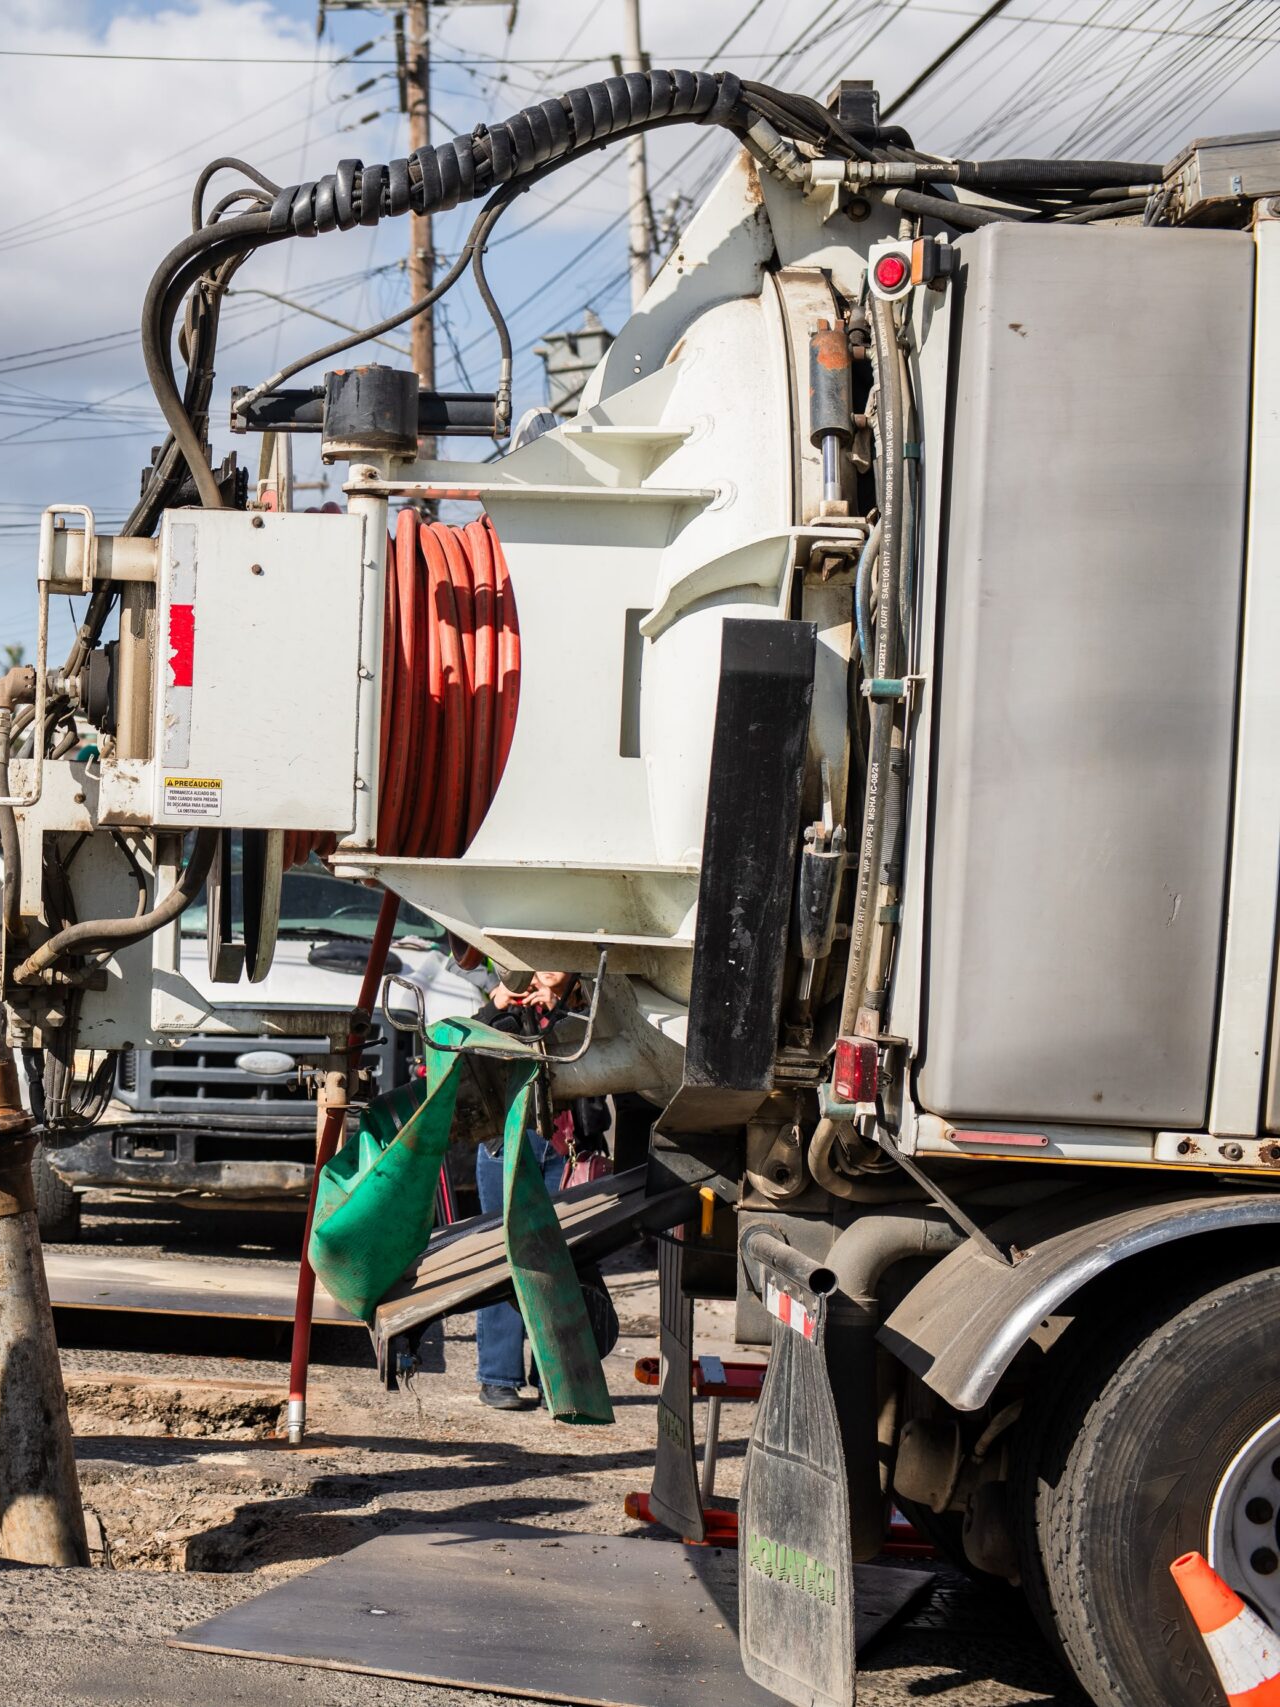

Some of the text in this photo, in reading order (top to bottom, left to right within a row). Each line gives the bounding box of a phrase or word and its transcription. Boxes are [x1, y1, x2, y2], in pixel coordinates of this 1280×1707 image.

[886, 440, 894, 464] MSHA
[886, 466, 894, 480] PSI
[885, 502, 893, 516] WP
[883, 552, 891, 566] R17
[882, 568, 890, 599] SAE100
[880, 604, 888, 628] KURT
[868, 796, 877, 820] MSHA
[866, 824, 874, 838] PSI
[864, 839, 873, 857] 3000
[863, 858, 871, 873] WP
[857, 906, 867, 922] R17
[854, 923, 864, 951] SAE100
